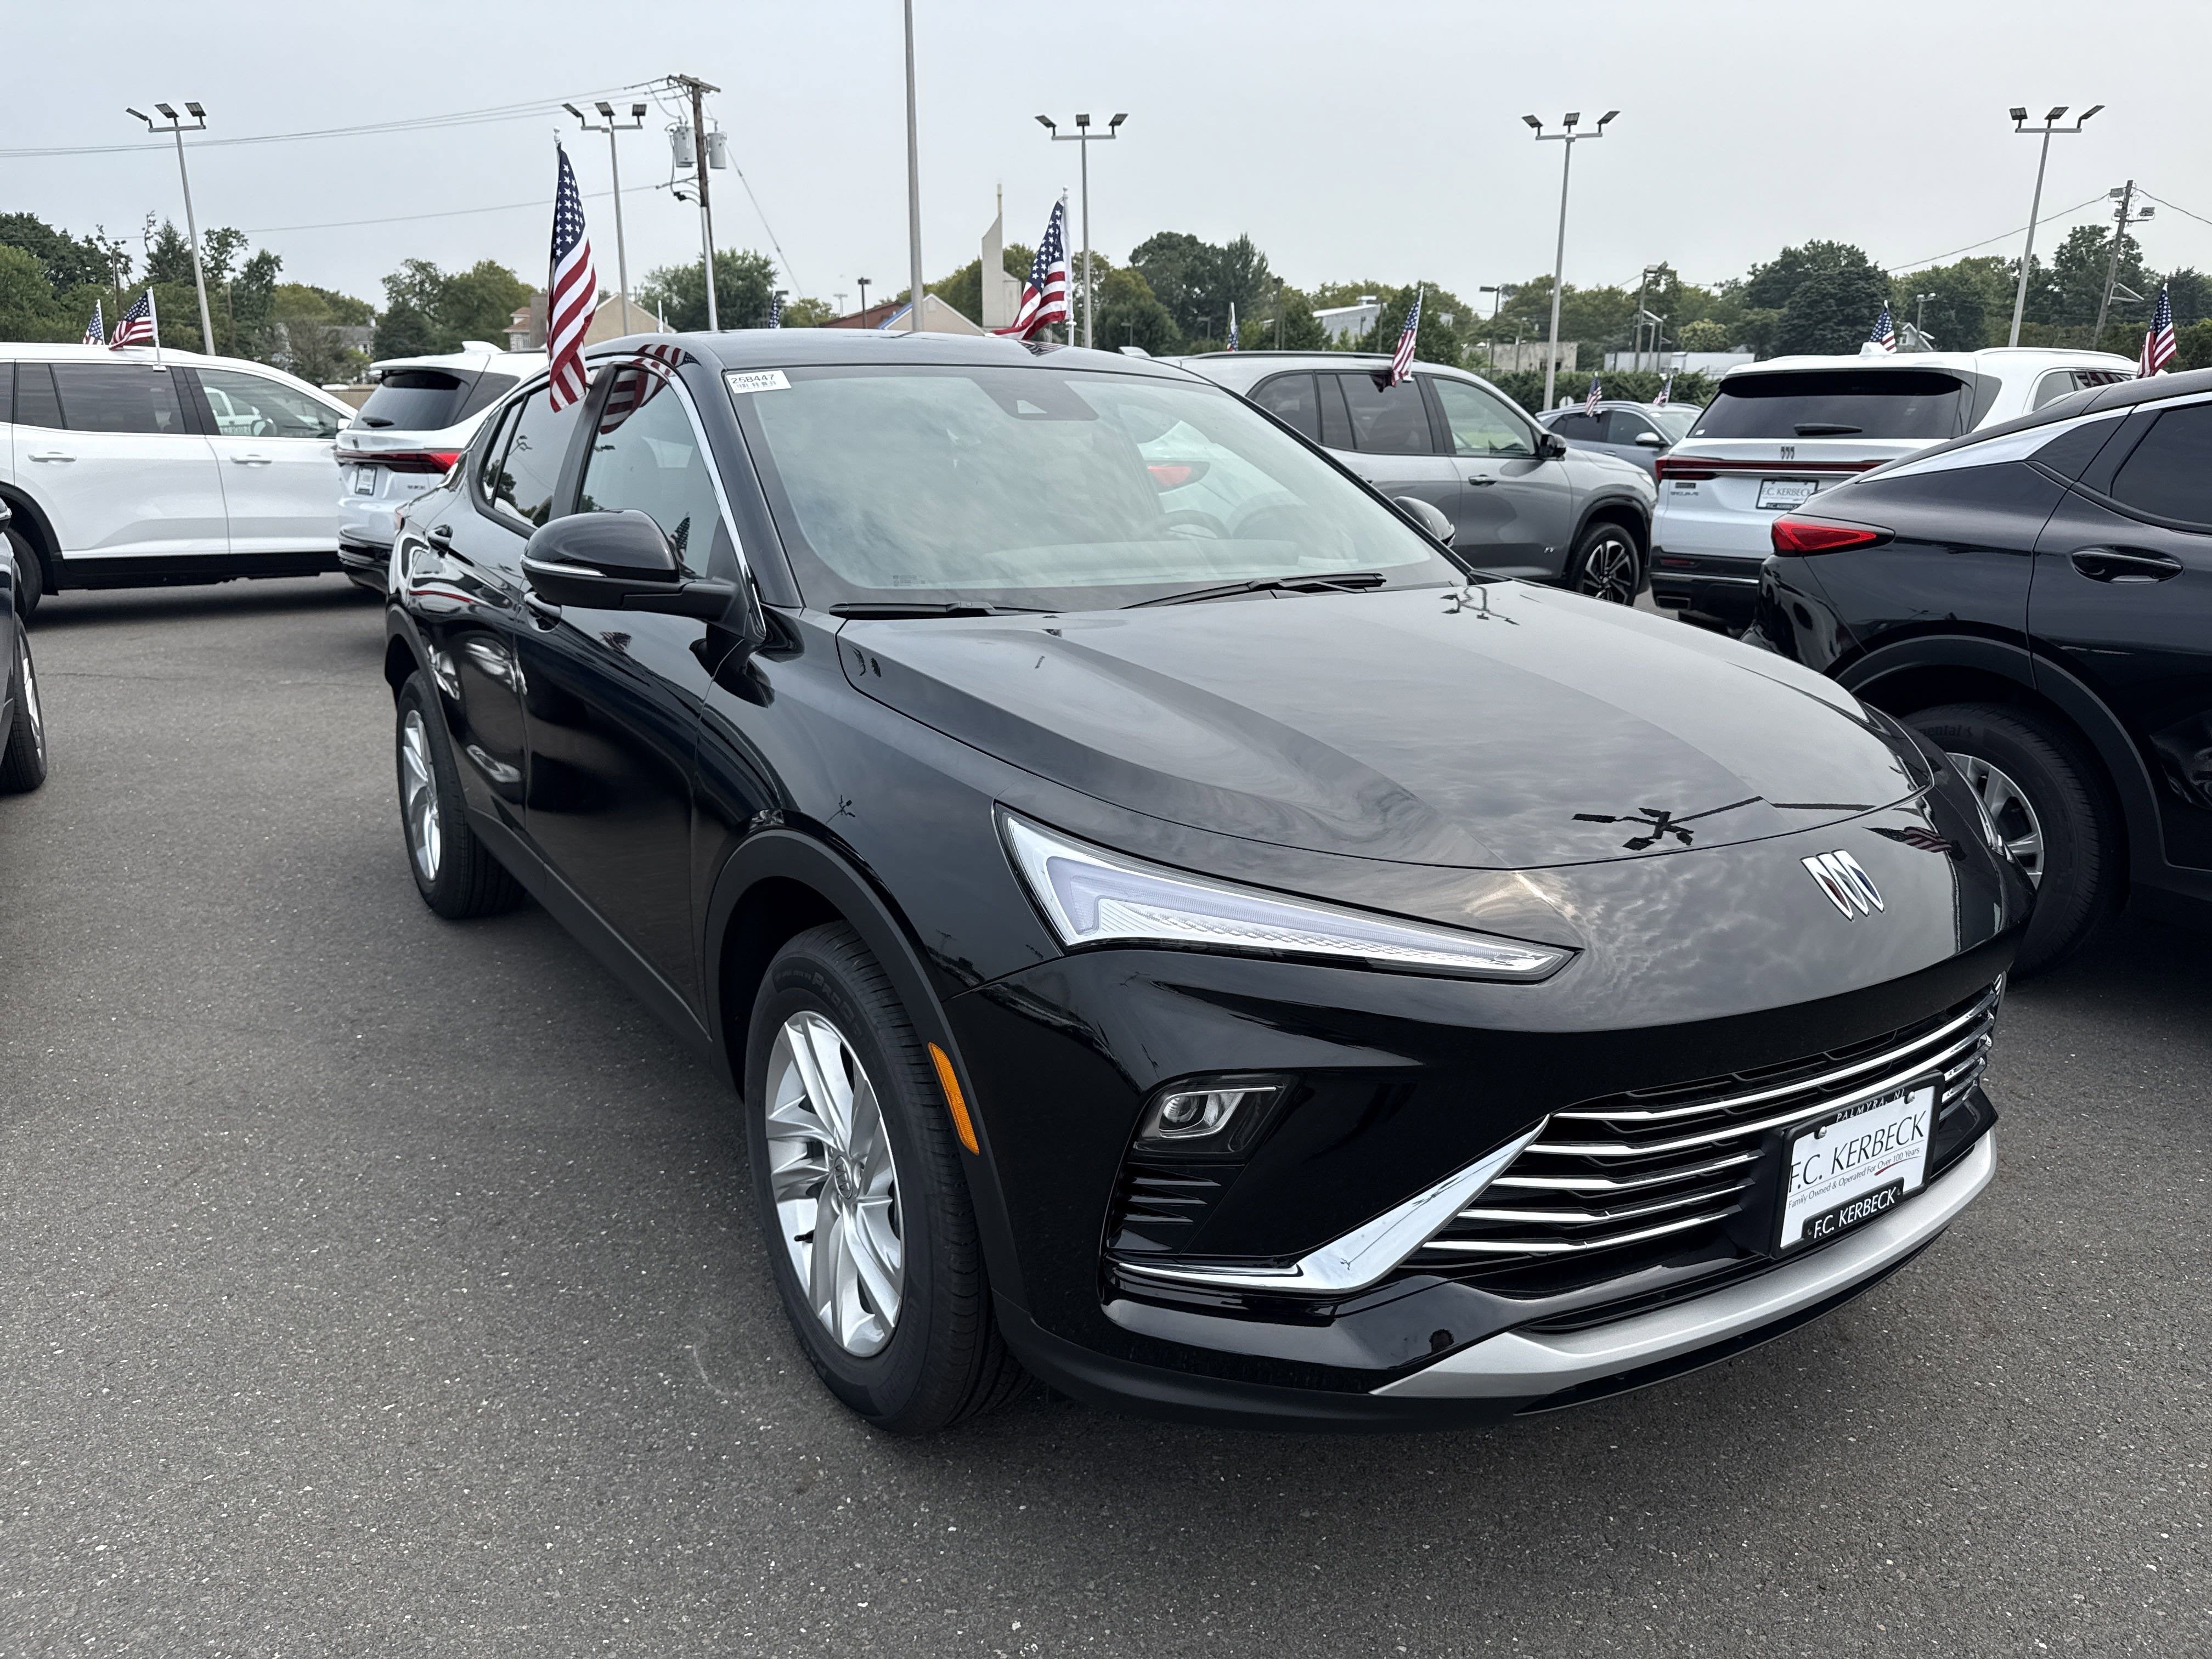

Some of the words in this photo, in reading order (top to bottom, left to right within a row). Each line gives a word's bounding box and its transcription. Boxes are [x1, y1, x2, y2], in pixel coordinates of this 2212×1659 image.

[731, 374, 774, 383] 25B447
[1777, 488, 1812, 496] KERBECK
[1788, 1154, 1823, 1193] F.C.
[1831, 1110, 1927, 1175] KERBECK
[1788, 1194, 1808, 1209] Family
[1808, 1182, 1831, 1199] Owned
[1832, 1181, 1837, 1189] &
[1838, 1167, 1866, 1187] Operated
[1867, 1164, 1876, 1174] For
[1877, 1158, 1892, 1169] Over
[1893, 1152, 1903, 1163] 100
[1905, 1147, 1920, 1158] Years
[1814, 1214, 1835, 1238] F.C.
[1838, 1187, 1897, 1228] KERBECK
